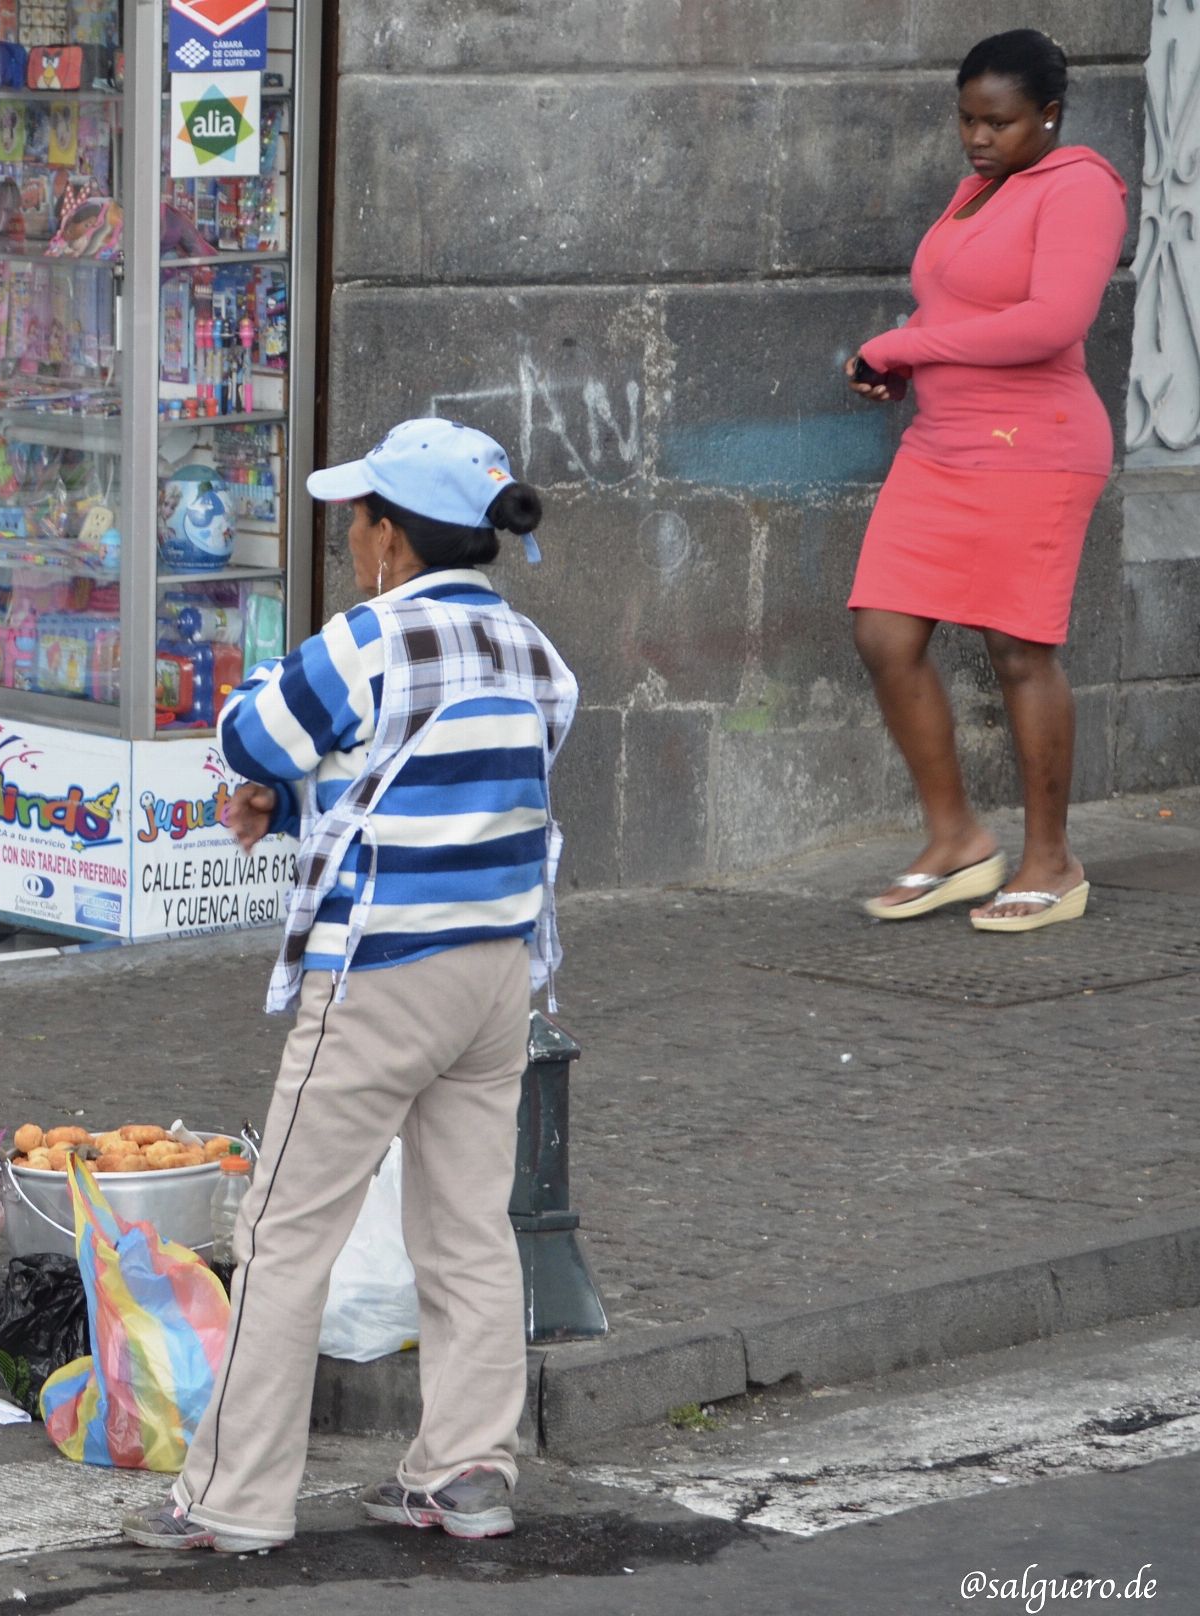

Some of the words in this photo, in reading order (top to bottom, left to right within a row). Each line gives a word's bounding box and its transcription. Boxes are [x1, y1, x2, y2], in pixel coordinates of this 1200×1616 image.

[213, 40, 243, 48] CÁMARA
[224, 49, 261, 57] COMERCIO
[213, 59, 223, 67] DE
[224, 59, 245, 67] QUITO
[193, 110, 236, 137] alia
[18, 834, 27, 842] tu
[30, 837, 66, 849] servicio
[2, 845, 18, 866] CON
[21, 848, 36, 868] SUS
[38, 852, 77, 877] TARJETAS
[79, 861, 127, 888] PREFERIDAS
[142, 860, 197, 893] CALLE:
[201, 850, 268, 888] BOLÍVAR
[272, 853, 296, 883] 613
[163, 898, 173, 927] Y
[176, 893, 239, 927] CUENCA
